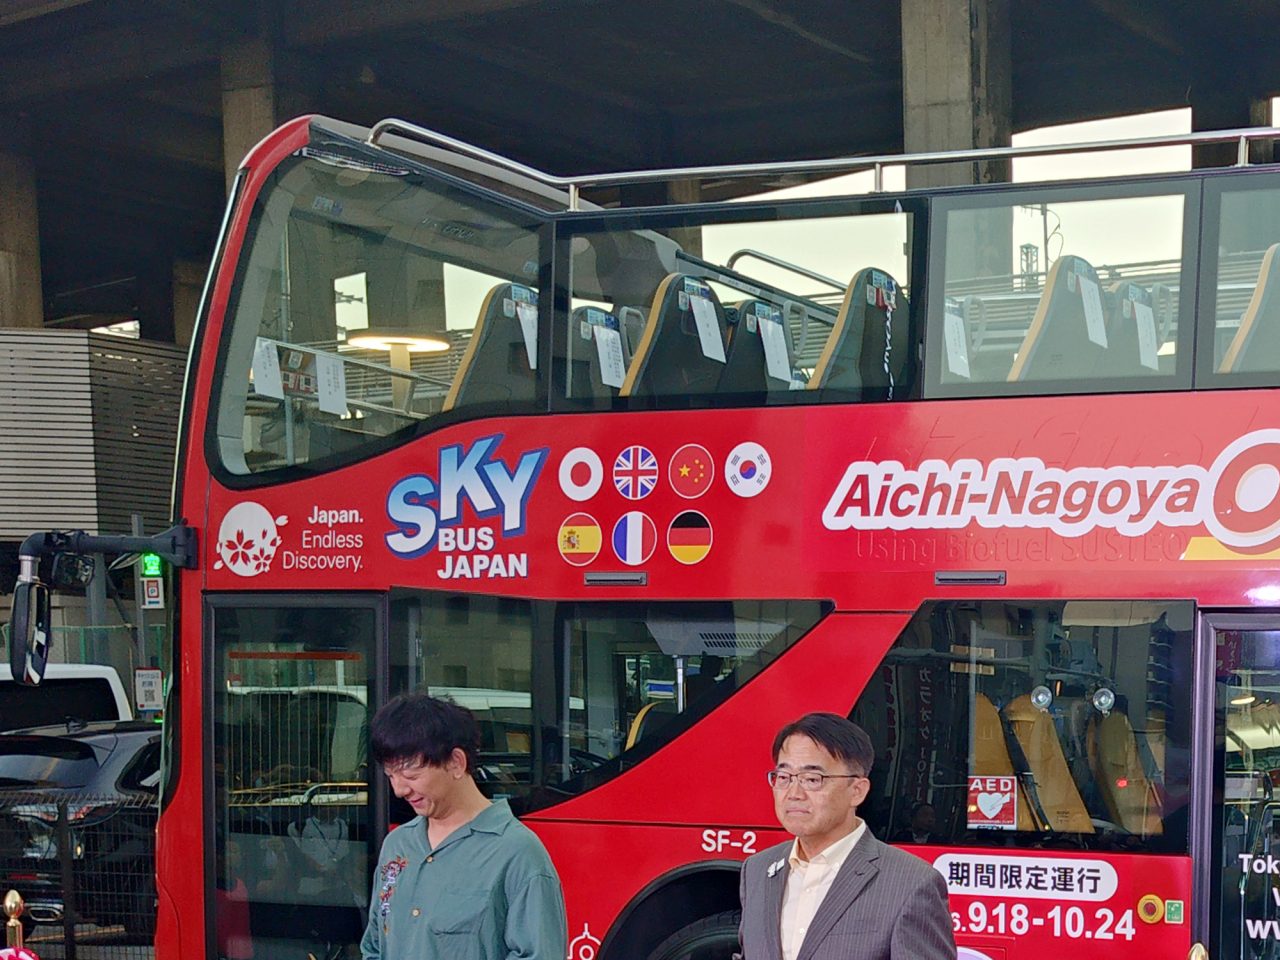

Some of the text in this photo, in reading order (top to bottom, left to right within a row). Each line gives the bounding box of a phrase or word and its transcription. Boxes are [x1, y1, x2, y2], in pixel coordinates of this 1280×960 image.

[385, 434, 550, 558] SKY
[827, 461, 1206, 532] Aichi-Nagoya
[307, 505, 364, 527] Japan.
[302, 529, 364, 549] Endless
[438, 527, 495, 551] BUS
[856, 531, 937, 564] Using
[944, 530, 1049, 563] Biofuel
[282, 551, 364, 573] Discovery.
[437, 553, 528, 579] JAPAN
[969, 778, 1012, 792] AED
[701, 829, 757, 853] SF-2
[947, 860, 1102, 895] 期間限定運行
